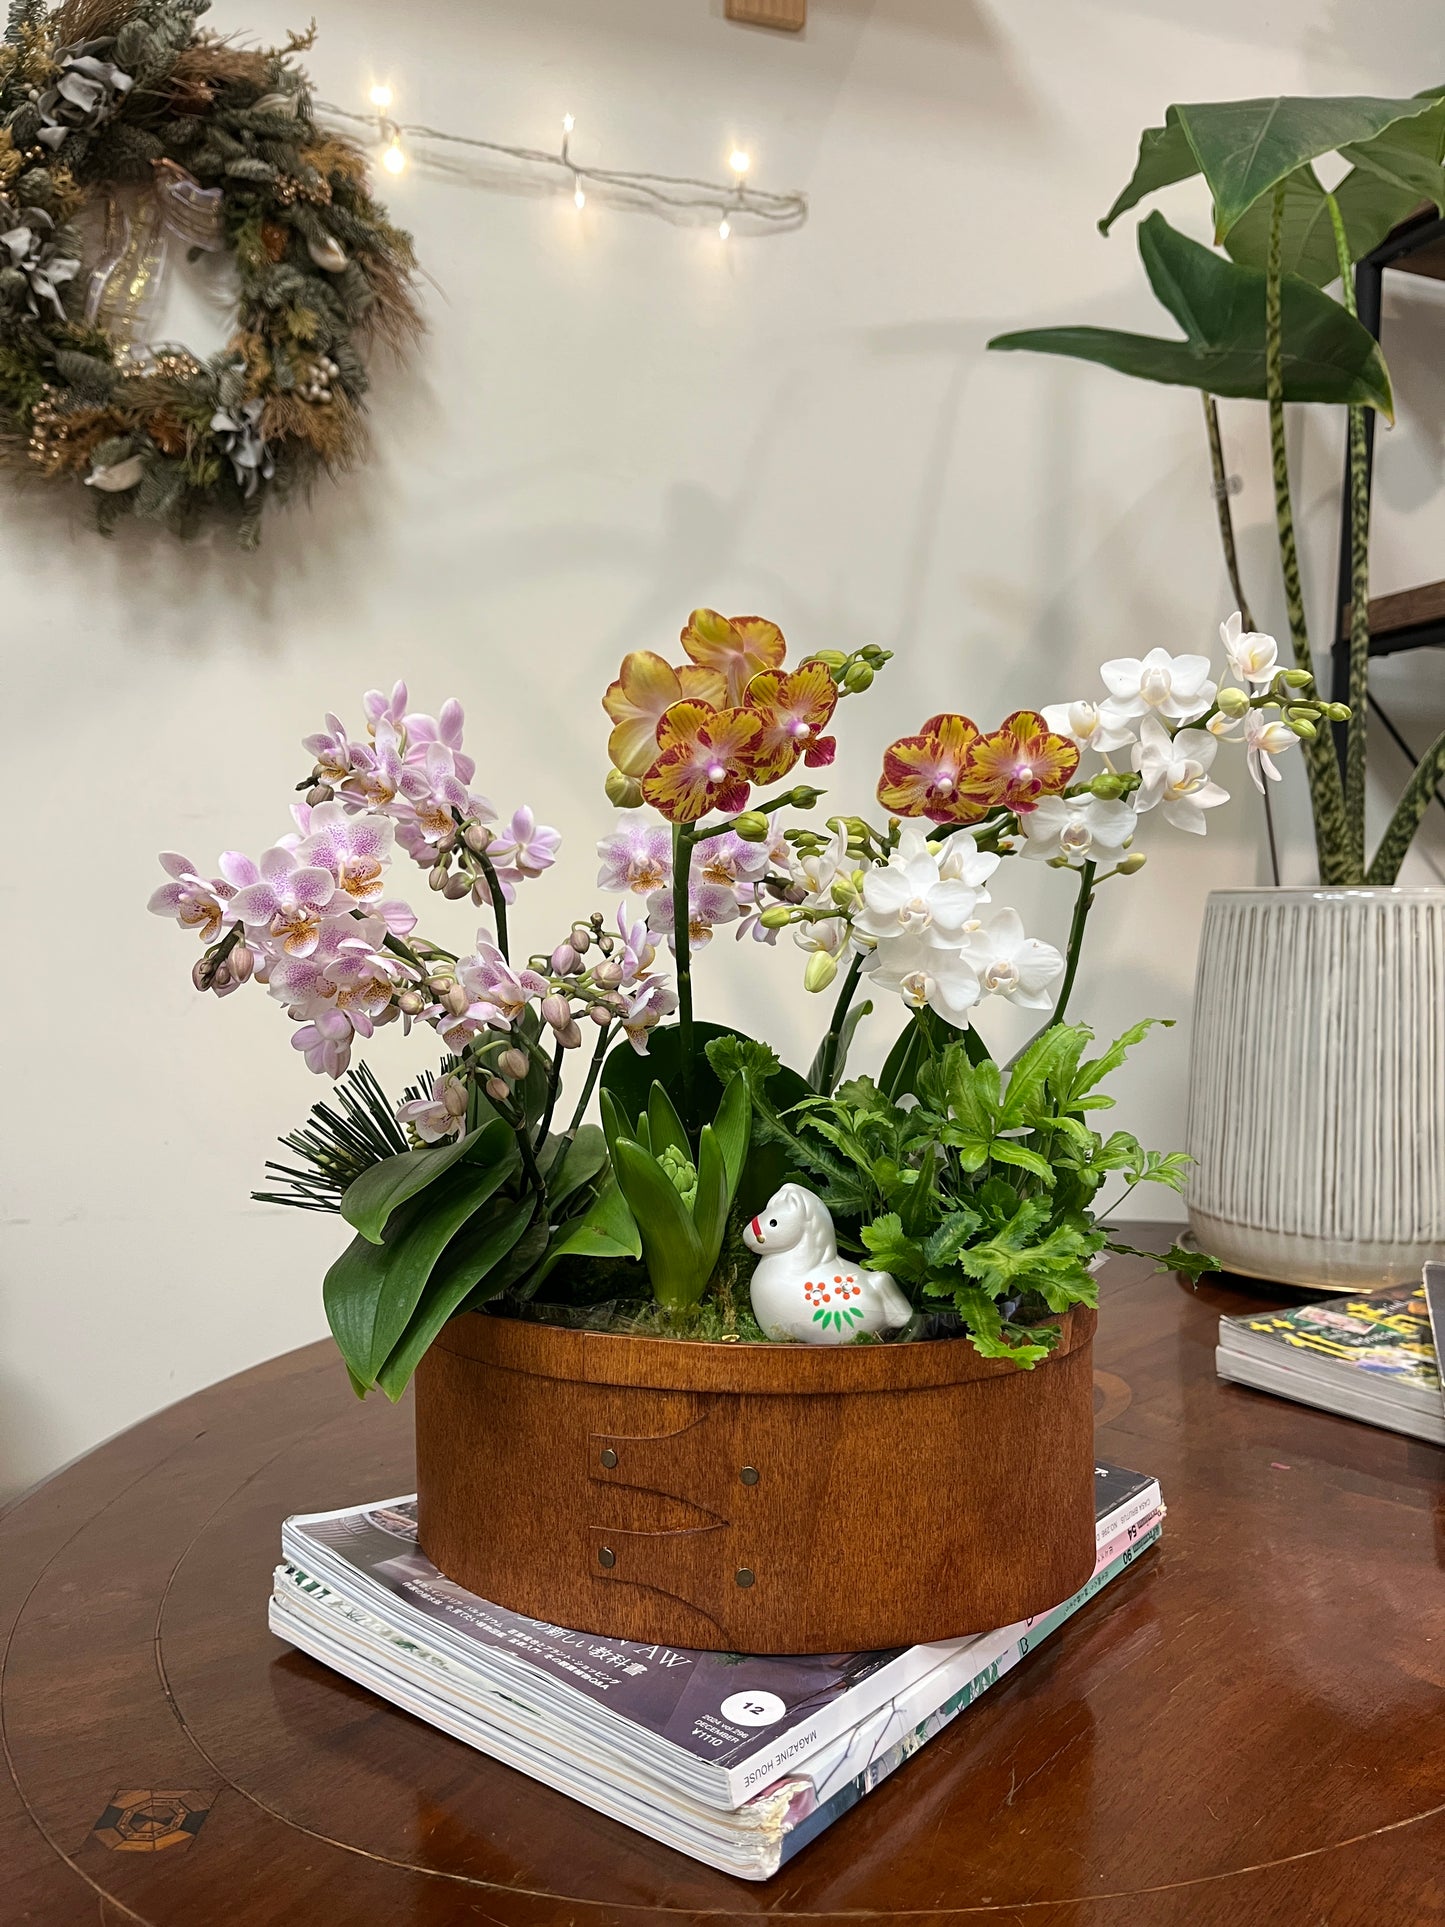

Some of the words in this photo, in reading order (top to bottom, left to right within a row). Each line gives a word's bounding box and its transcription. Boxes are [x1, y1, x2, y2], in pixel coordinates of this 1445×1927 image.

[1120, 1507, 1139, 1524] BRUTUS
[1127, 1524, 1137, 1541] 54
[1122, 1548, 1133, 1566] 90
[743, 1702, 765, 1715] 12
[693, 1719, 740, 1743] DECEMBER
[701, 1714, 722, 1727] 2024
[720, 1722, 750, 1739] vol.296
[691, 1727, 724, 1747] ¥1110
[775, 1729, 818, 1767] MAGAZINE
[743, 1762, 774, 1788] HOUSE
